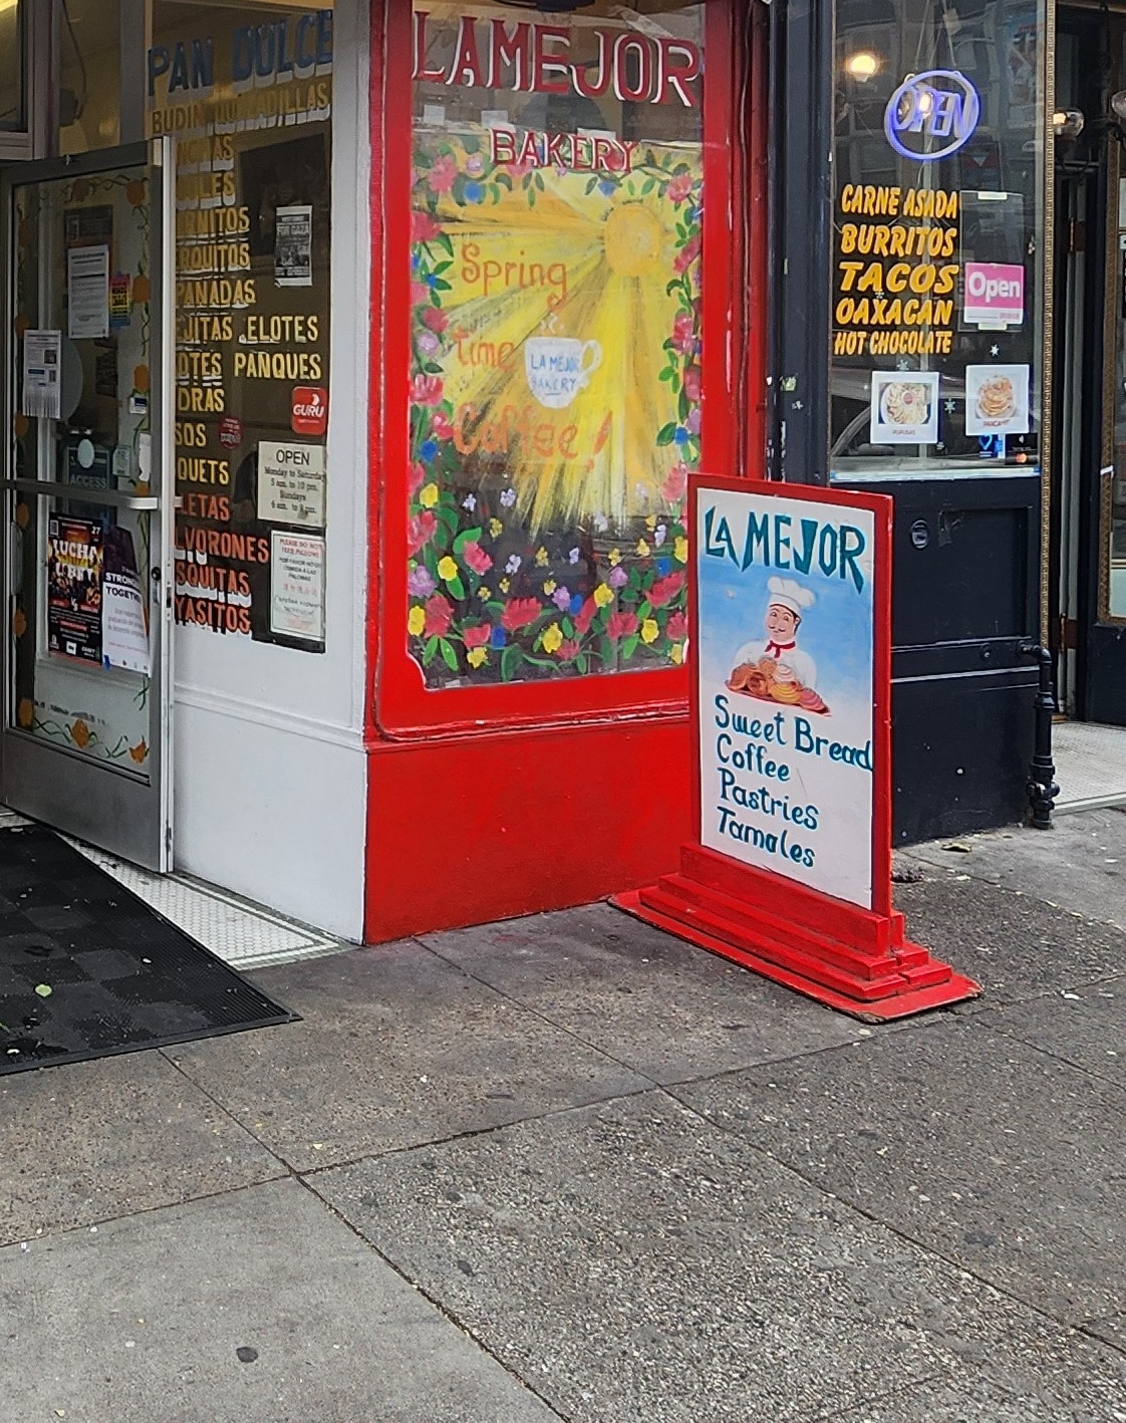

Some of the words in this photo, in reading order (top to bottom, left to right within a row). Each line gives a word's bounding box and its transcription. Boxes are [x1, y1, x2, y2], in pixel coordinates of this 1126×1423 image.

[148, 36, 214, 97] PAN
[232, 8, 333, 83] DULCE
[894, 83, 978, 138] OPEN
[489, 128, 641, 174] BAKERY
[841, 184, 901, 216] CARNE
[903, 188, 957, 219] ASADA
[840, 223, 957, 258] BURRITOS
[461, 243, 568, 310] Spring
[839, 262, 960, 294] TACOS
[968, 272, 1021, 303] Open
[836, 297, 953, 325] OAXACAN
[247, 316, 319, 341] ELOTES
[834, 331, 867, 355] HOT
[869, 330, 953, 355] CHOCOLATE
[451, 327, 516, 371] time
[531, 354, 546, 369] LA
[550, 356, 580, 372] MEJOR
[234, 353, 322, 380] PANQUES
[532, 376, 577, 392] BAKERY
[293, 404, 325, 418] GURU
[264, 466, 287, 478] Monday
[276, 449, 310, 465] OPEN
[280, 490, 306, 502] Sundays
[705, 506, 741, 568] LA
[741, 511, 865, 595] MEJOR
[715, 694, 787, 745] Sweet
[794, 716, 873, 772] Bread
[716, 733, 790, 782] Coffee
[717, 767, 819, 830] Pastries
[717, 806, 816, 867] Tamales
